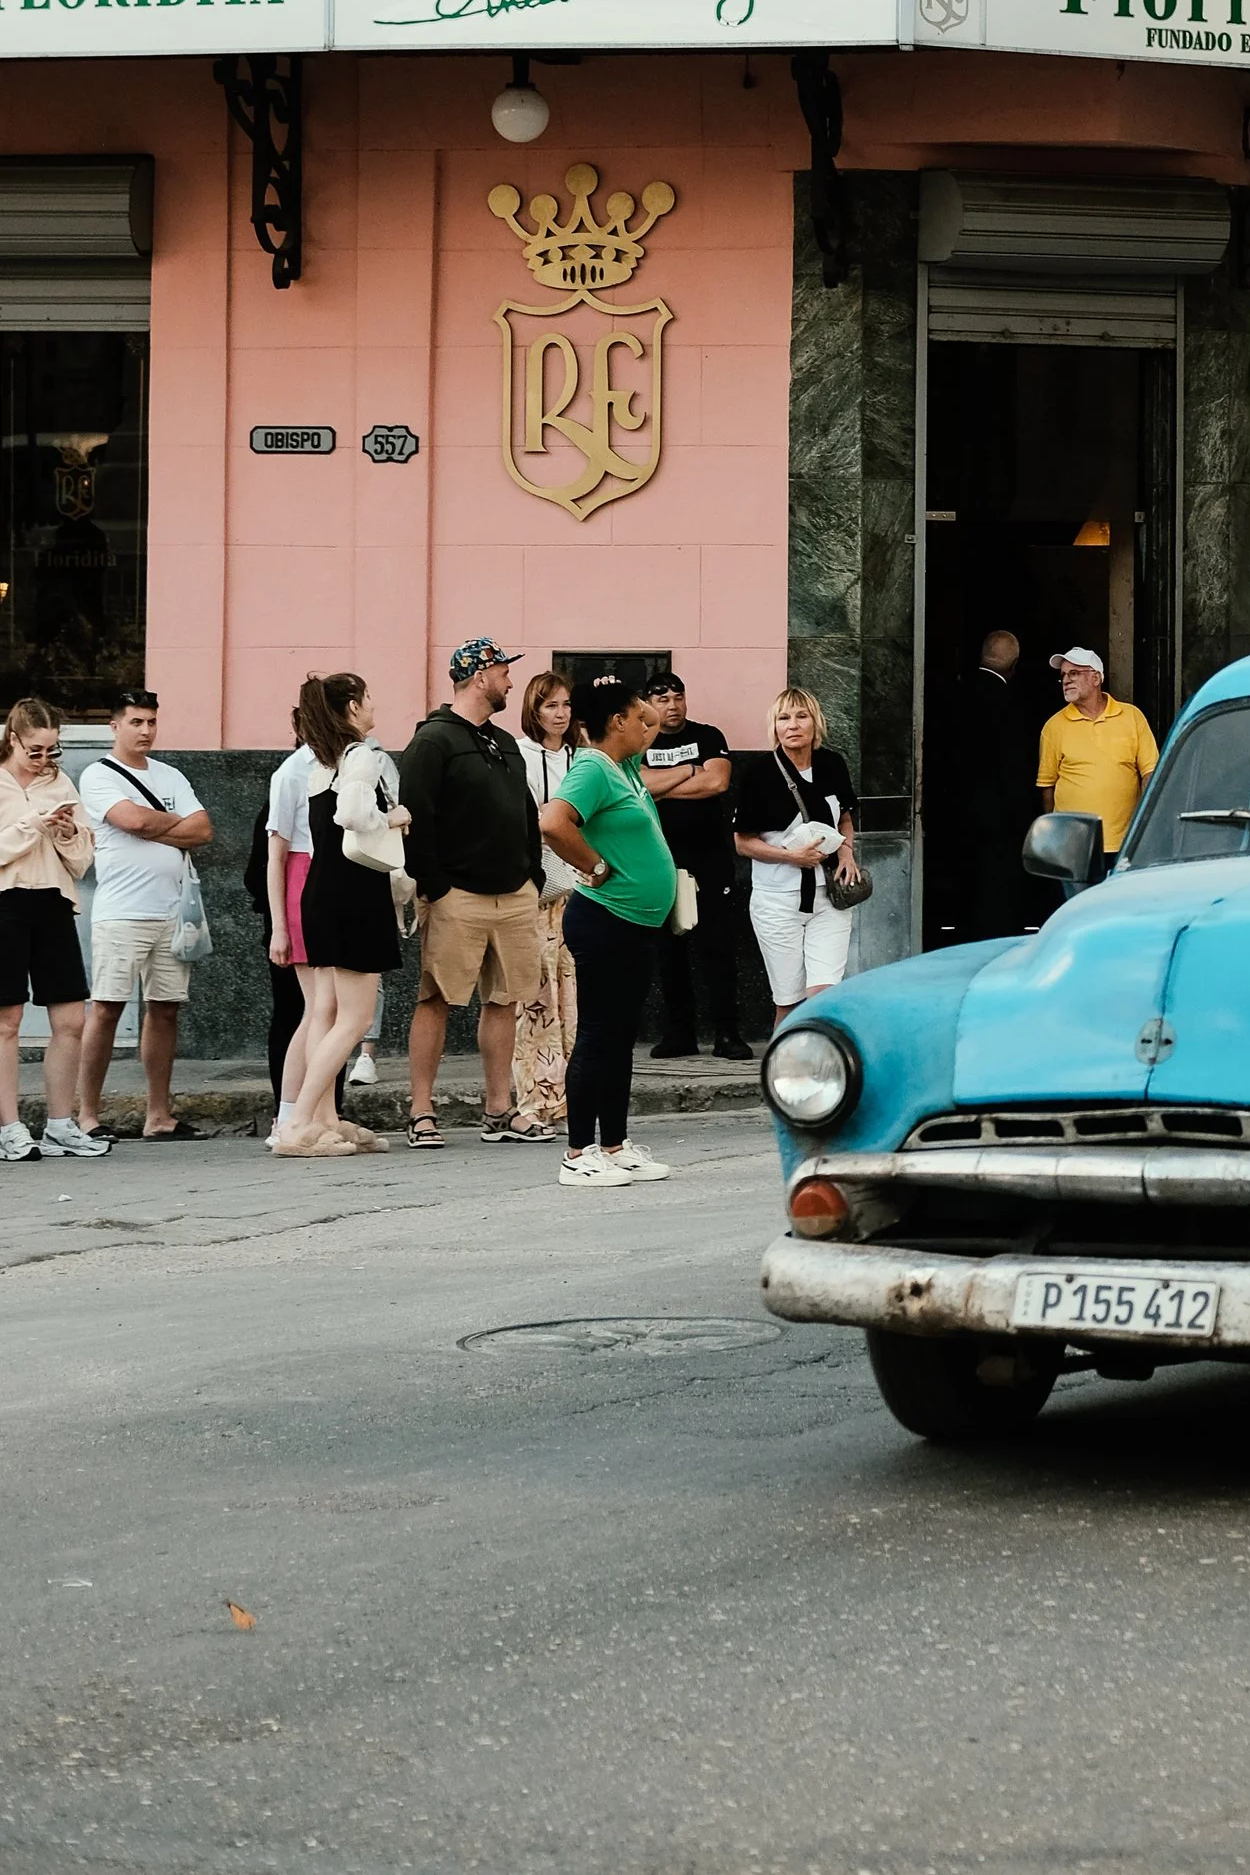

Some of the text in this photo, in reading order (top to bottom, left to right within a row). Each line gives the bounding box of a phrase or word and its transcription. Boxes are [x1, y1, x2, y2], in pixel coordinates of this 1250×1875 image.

[1146, 28, 1232, 53] FUNDADO
[264, 431, 321, 449] OBISPO
[373, 434, 408, 456] 557
[34, 550, 118, 567] Floridita
